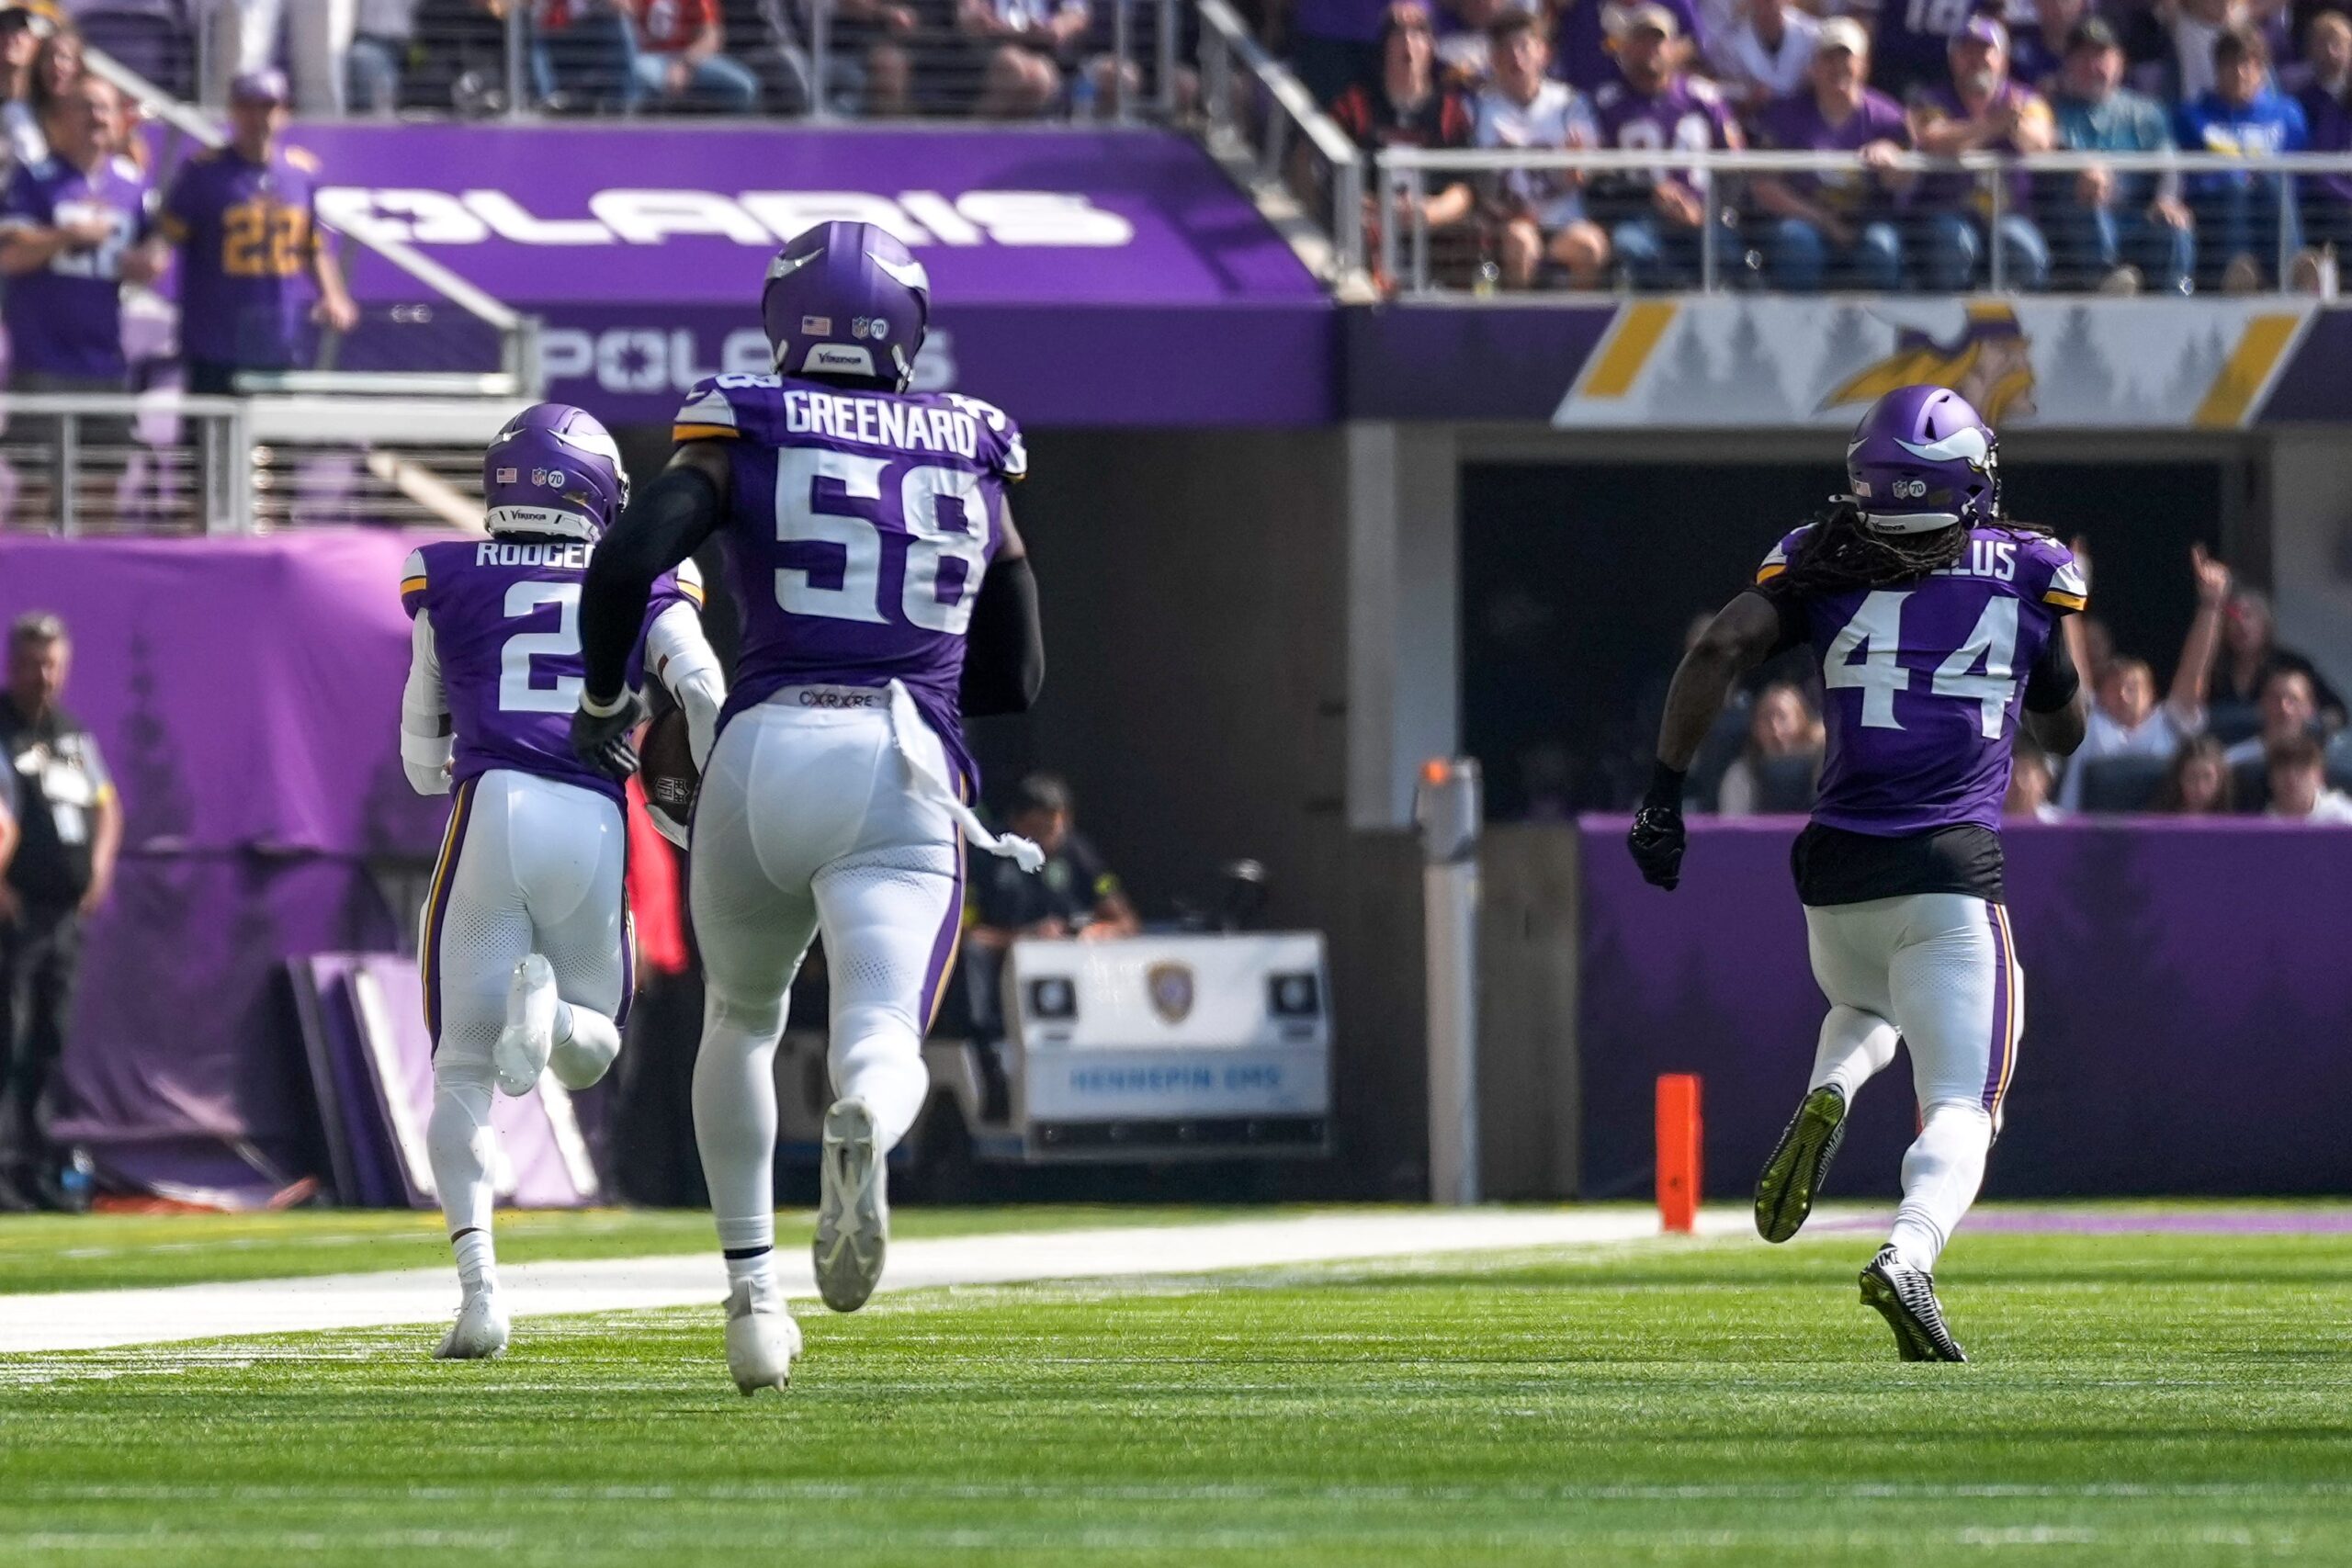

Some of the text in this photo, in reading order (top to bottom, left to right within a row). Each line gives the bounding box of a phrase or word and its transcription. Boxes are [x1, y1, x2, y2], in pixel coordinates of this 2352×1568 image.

[223, 205, 310, 276] 22
[315, 186, 1136, 245] OLARIS
[873, 322, 885, 334] 70
[783, 389, 978, 459] GREENARD
[550, 473, 562, 485] 70
[1911, 483, 1923, 493] 70
[775, 446, 990, 636] 58
[499, 581, 586, 714] 2
[1823, 590, 2020, 739] 44
[1223, 1064, 1281, 1090] EMS
